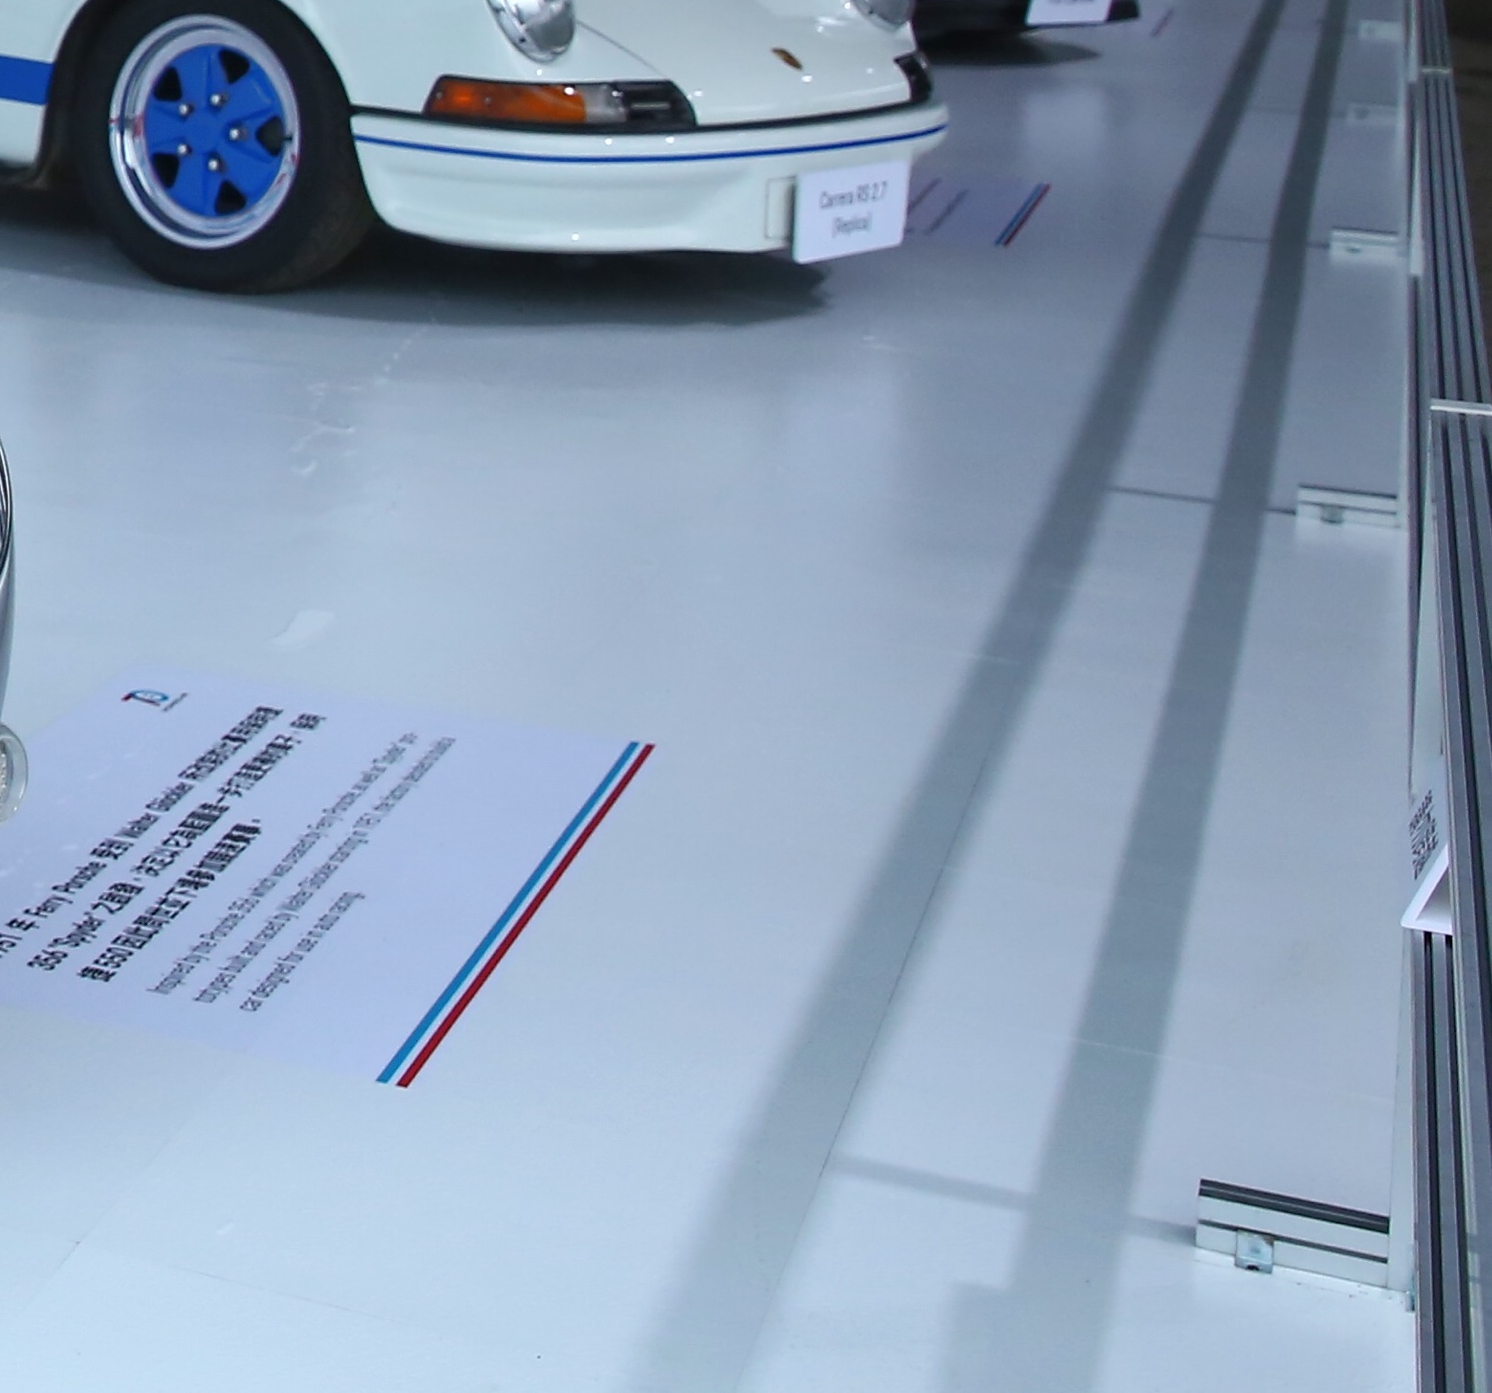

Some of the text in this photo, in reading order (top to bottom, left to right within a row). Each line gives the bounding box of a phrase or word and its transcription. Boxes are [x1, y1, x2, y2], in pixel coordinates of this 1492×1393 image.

[5, 918, 39, 931] 年
[23, 895, 73, 918] Ferry
[51, 861, 107, 894] Porsche
[90, 839, 134, 860] 受到
[313, 913, 340, 931] auto
[27, 949, 68, 970] 356
[93, 947, 133, 968] 550
[147, 962, 194, 994] Inspired
[249, 962, 295, 998] designed
[239, 996, 263, 1012] car
